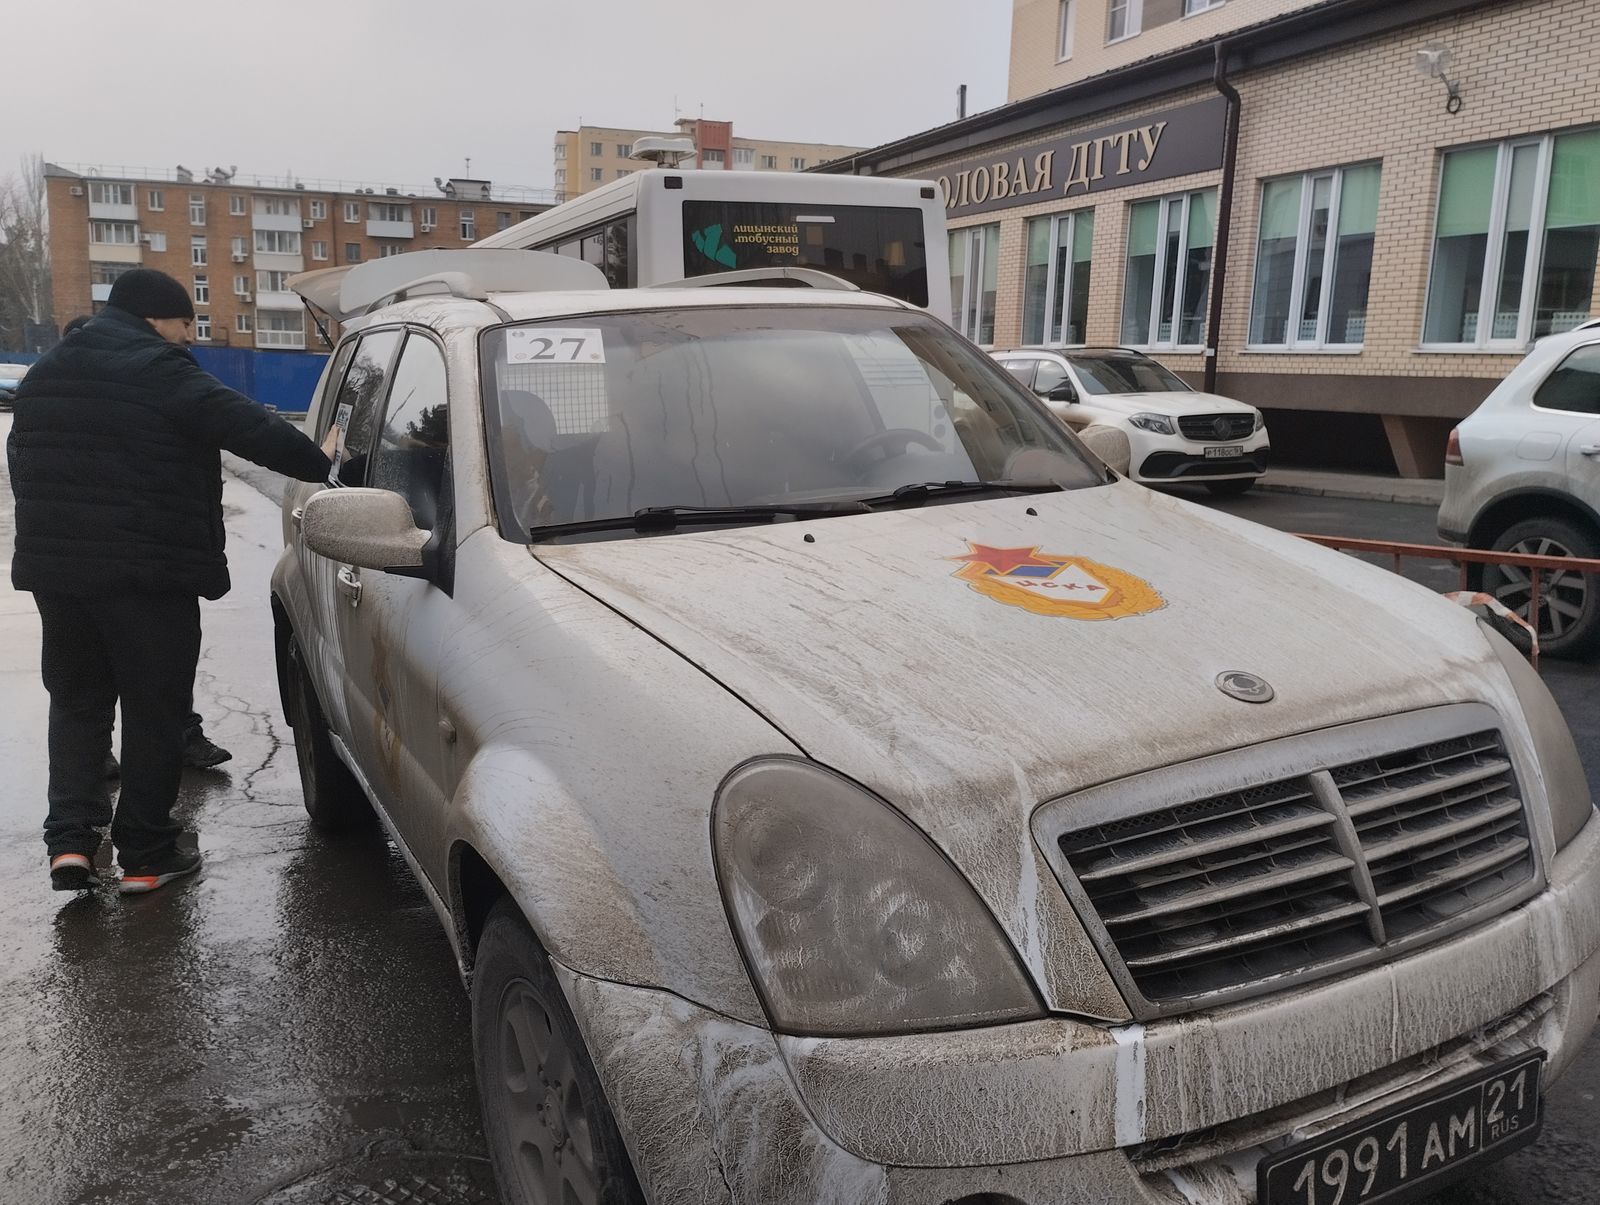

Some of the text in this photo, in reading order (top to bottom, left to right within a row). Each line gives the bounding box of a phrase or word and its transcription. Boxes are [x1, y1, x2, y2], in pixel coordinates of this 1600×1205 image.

[1063, 121, 1169, 196] ДГТУ
[766, 246, 799, 257] завод
[529, 337, 587, 361] 27
[1015, 580, 1106, 591] ЦСКА
[1293, 1121, 1408, 1205] 1991
[1487, 1070, 1527, 1125] 21
[1490, 1113, 1520, 1141] RUS
